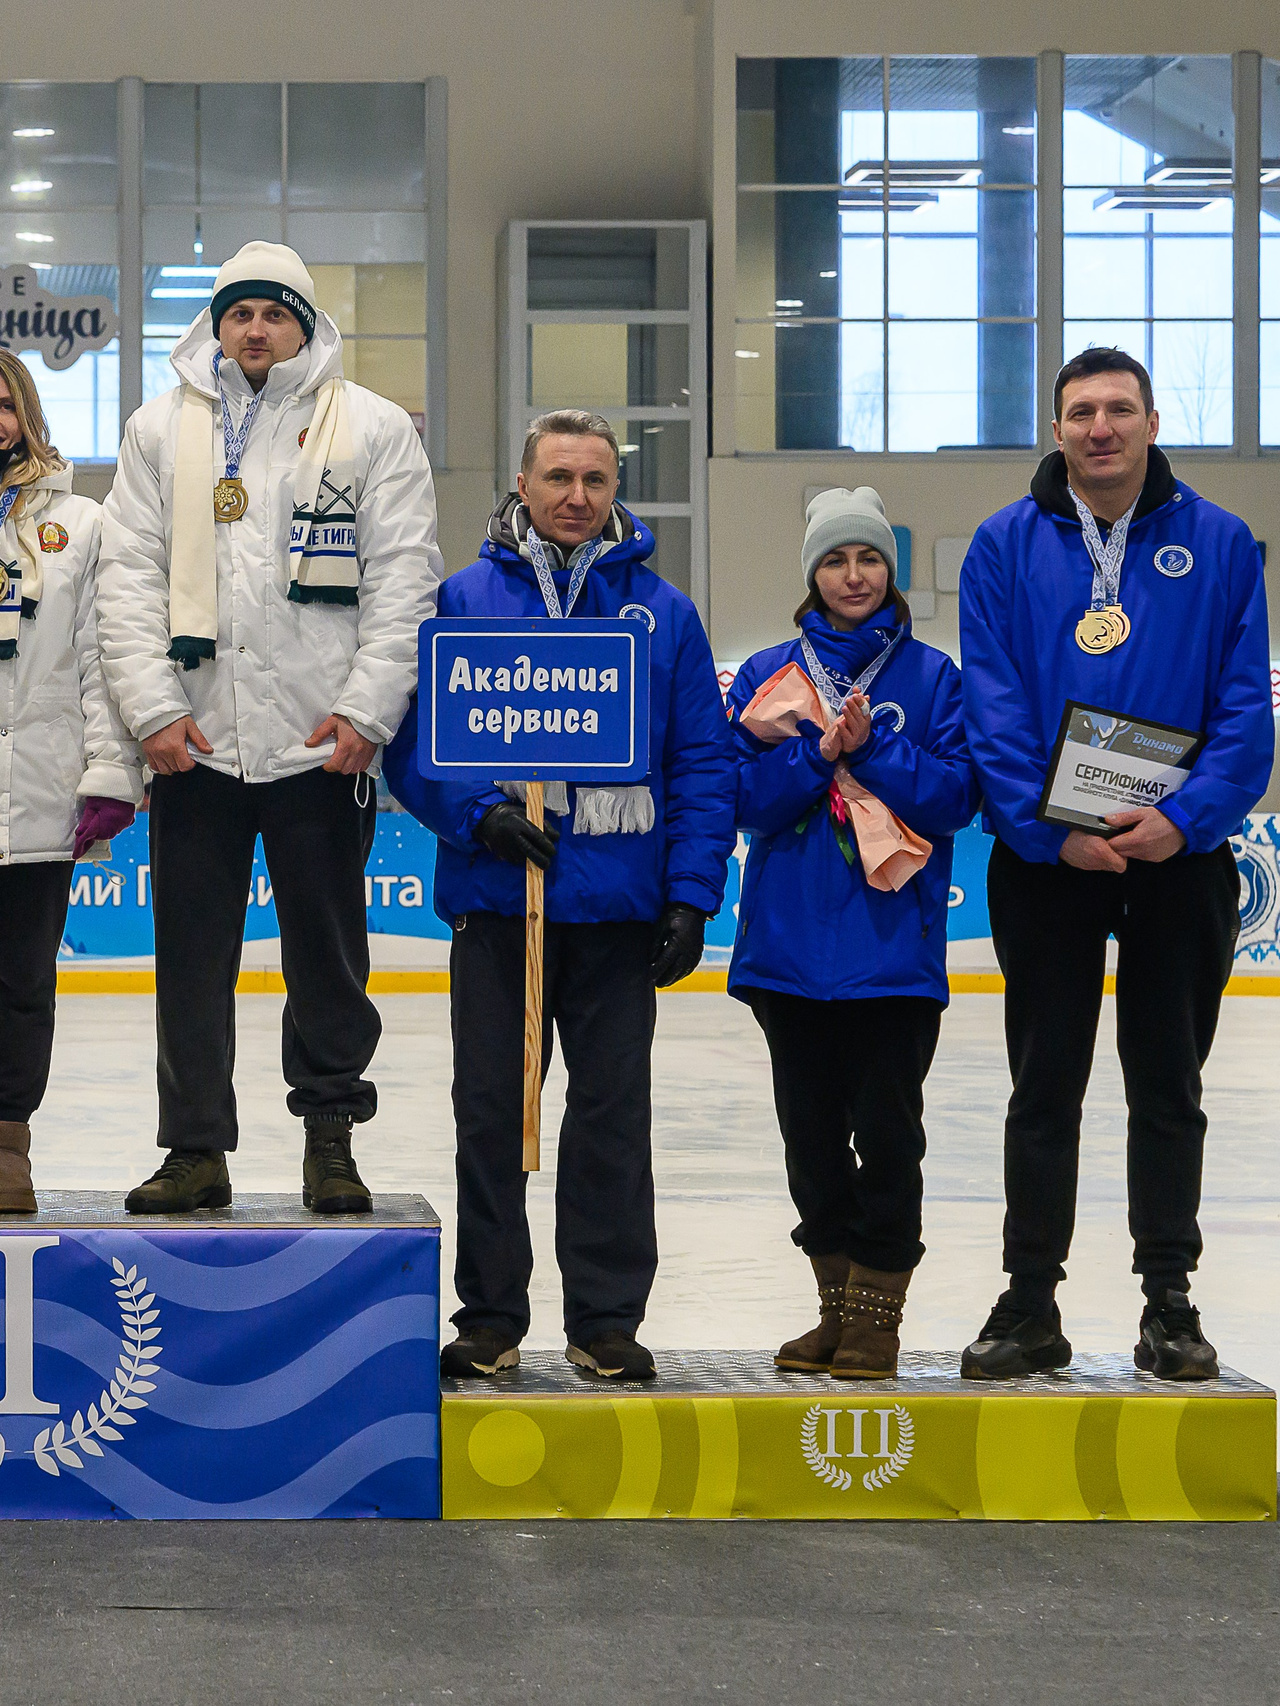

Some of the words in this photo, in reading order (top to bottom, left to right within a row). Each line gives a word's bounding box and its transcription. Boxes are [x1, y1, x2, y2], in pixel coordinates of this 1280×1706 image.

[448, 655, 619, 694] Академия
[468, 705, 599, 745] сервиса
[1075, 763, 1168, 798] СЕРТИФИКАТ
[820, 1408, 896, 1458] III
